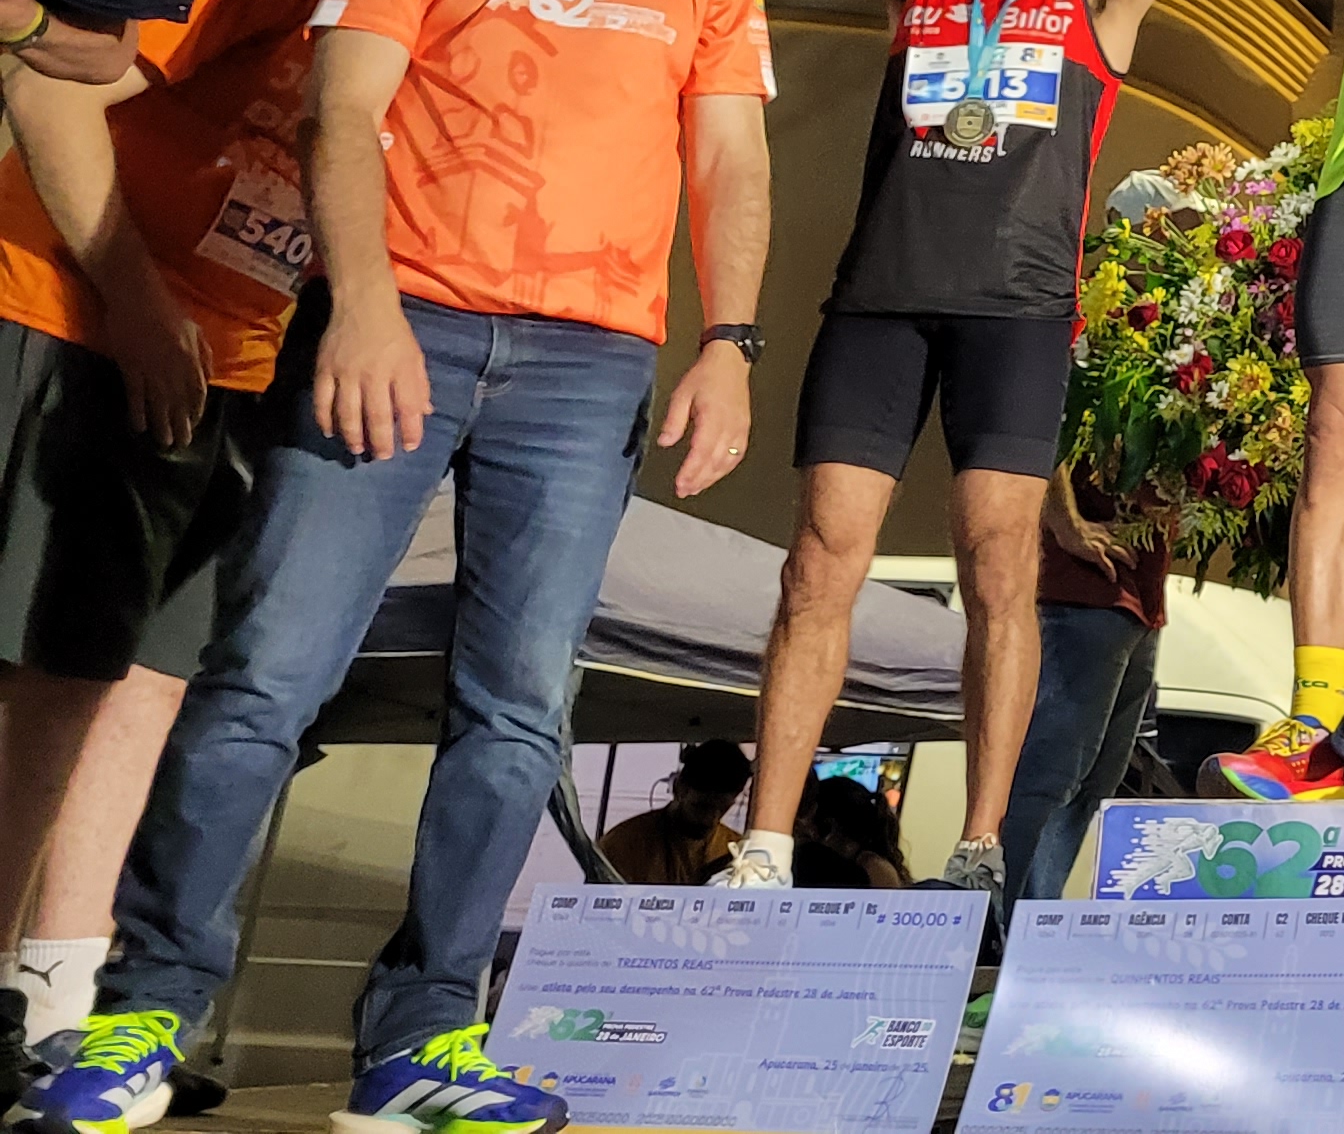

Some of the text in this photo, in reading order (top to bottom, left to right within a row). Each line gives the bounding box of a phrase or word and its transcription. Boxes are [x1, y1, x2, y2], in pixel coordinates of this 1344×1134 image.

[1002, 6, 1073, 33] Bilfor
[910, 140, 995, 163] RUNNERS
[239, 210, 313, 264] 540
[1197, 820, 1342, 898] 62ª
[1315, 875, 1344, 896] 28
[808, 902, 841, 914] CHEQUE
[891, 912, 947, 928] 300,00
[1036, 911, 1339, 926] COMP BANCO AGÊNCIA CONTA C2 CHEQUE
[618, 957, 678, 970] TREZENTOS
[1111, 973, 1184, 985] QUINHENTOS
[1227, 999, 1305, 1010] Prova Pedestre
[887, 1020, 921, 1033] BANCO
[619, 1032, 665, 1042] JANEIRO
[883, 1034, 927, 1048] ESPORTE
[1065, 1091, 1123, 1101] APUCARANA
